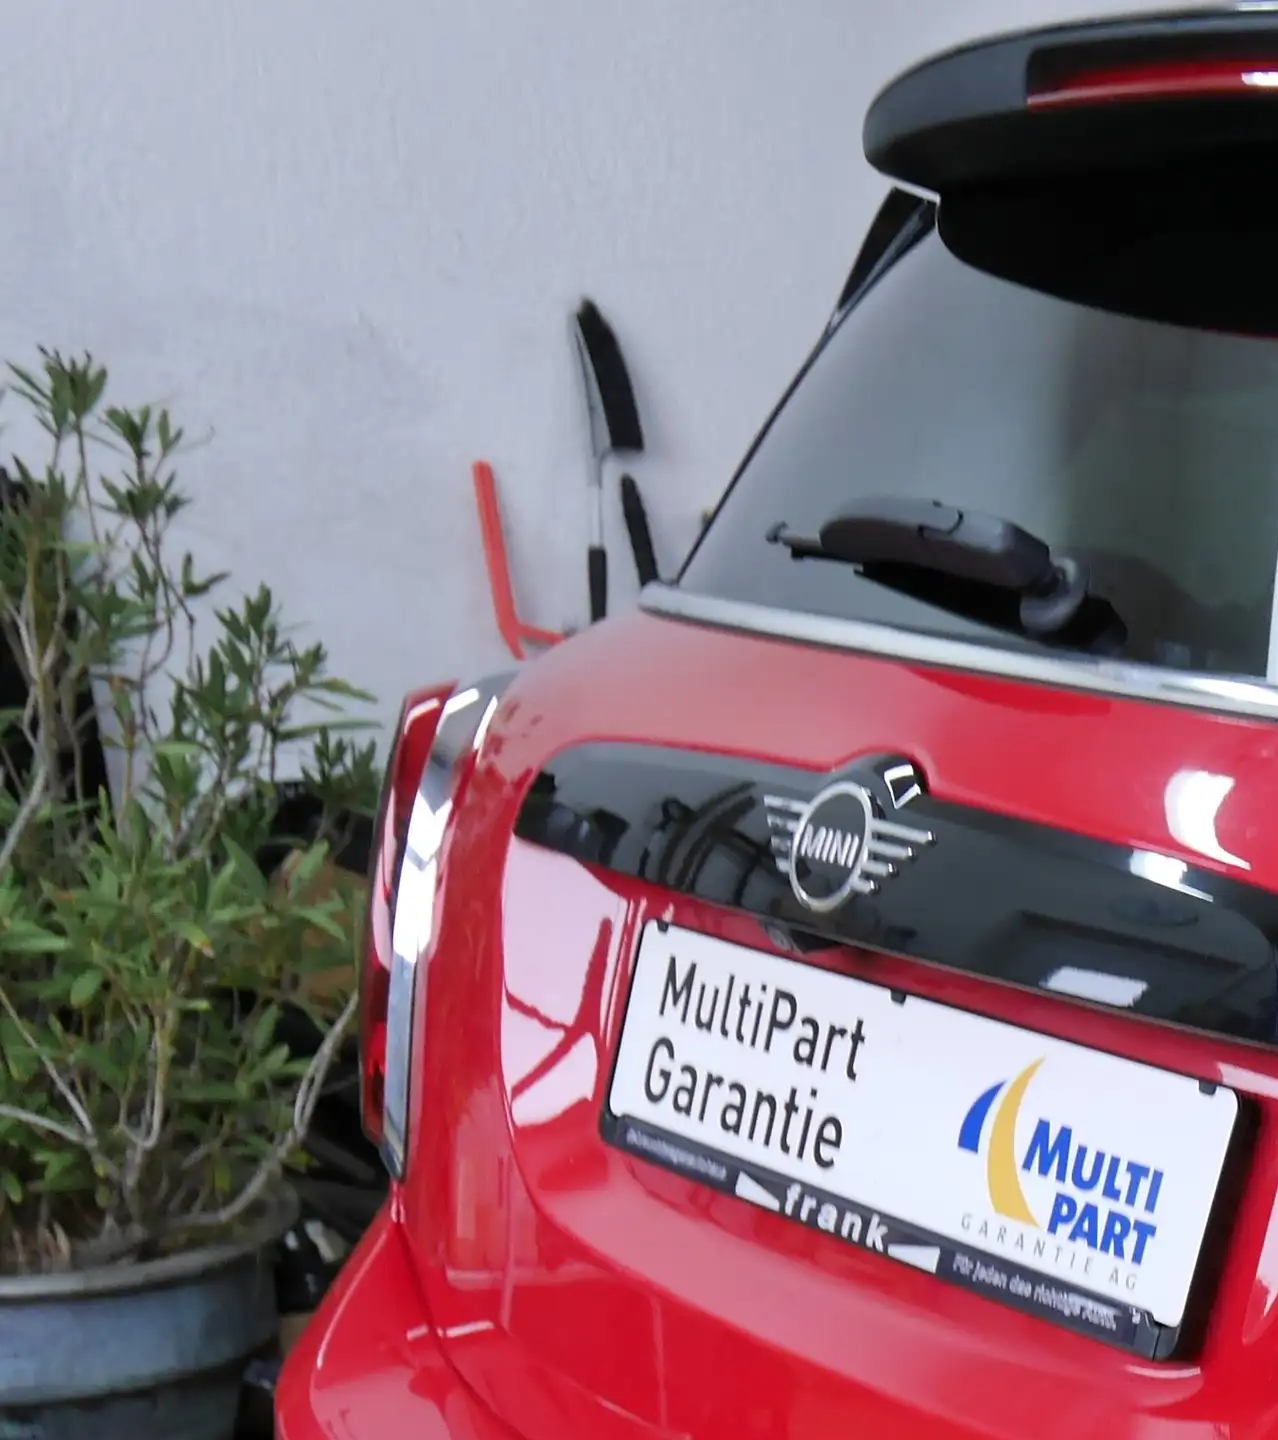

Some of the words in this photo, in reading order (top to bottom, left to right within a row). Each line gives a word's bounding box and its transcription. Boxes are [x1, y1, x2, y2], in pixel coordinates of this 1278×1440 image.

[801, 823, 859, 868] MINI
[659, 956, 865, 1081] MultiPart
[644, 1037, 843, 1170] Garantie
[1022, 1118, 1164, 1213] MULTI
[785, 1183, 888, 1252] frank
[961, 1213, 1093, 1273] GARANTIE
[1109, 1267, 1138, 1291] AG
[1047, 1192, 1157, 1266] PART
